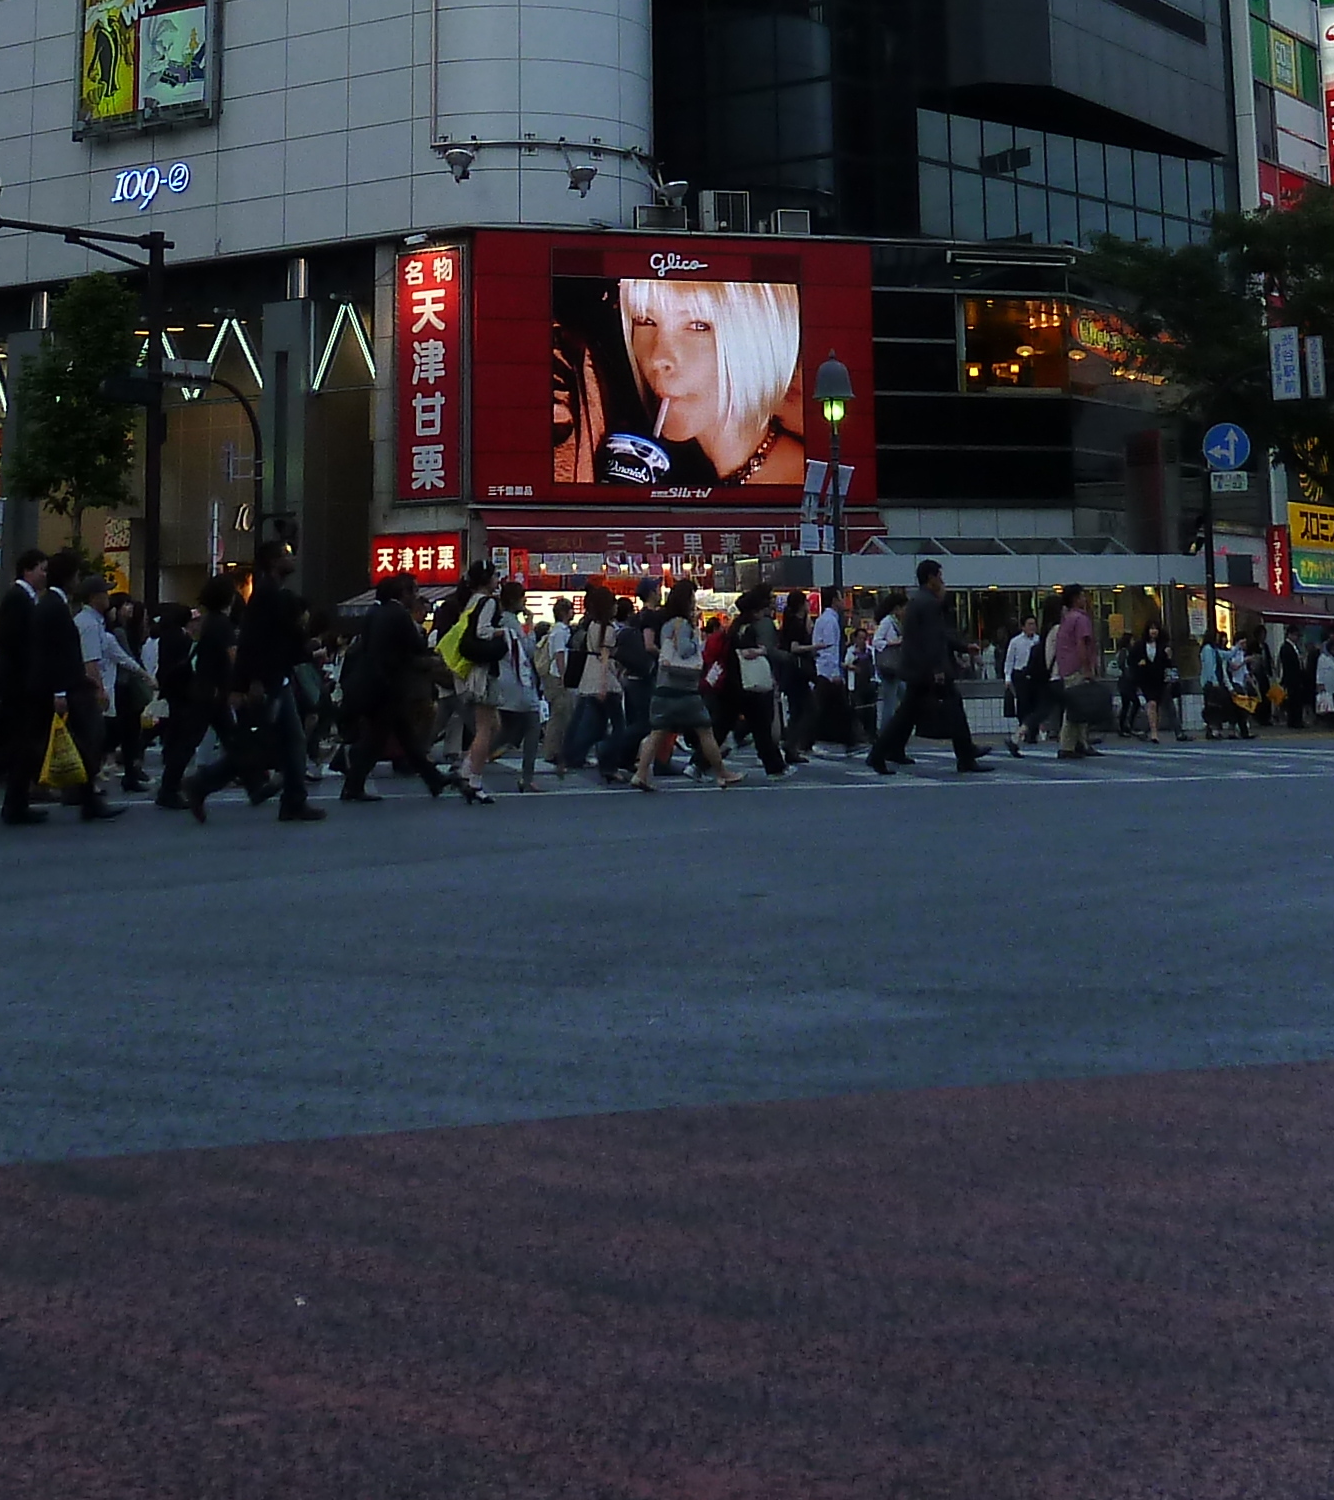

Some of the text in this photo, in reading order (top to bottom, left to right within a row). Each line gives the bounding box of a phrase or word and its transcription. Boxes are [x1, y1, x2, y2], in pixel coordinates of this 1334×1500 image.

[404, 257, 453, 286] 名物
[650, 254, 708, 277] Glico
[411, 288, 447, 491] 天津甘栗
[376, 545, 455, 573] 天津甘栗
